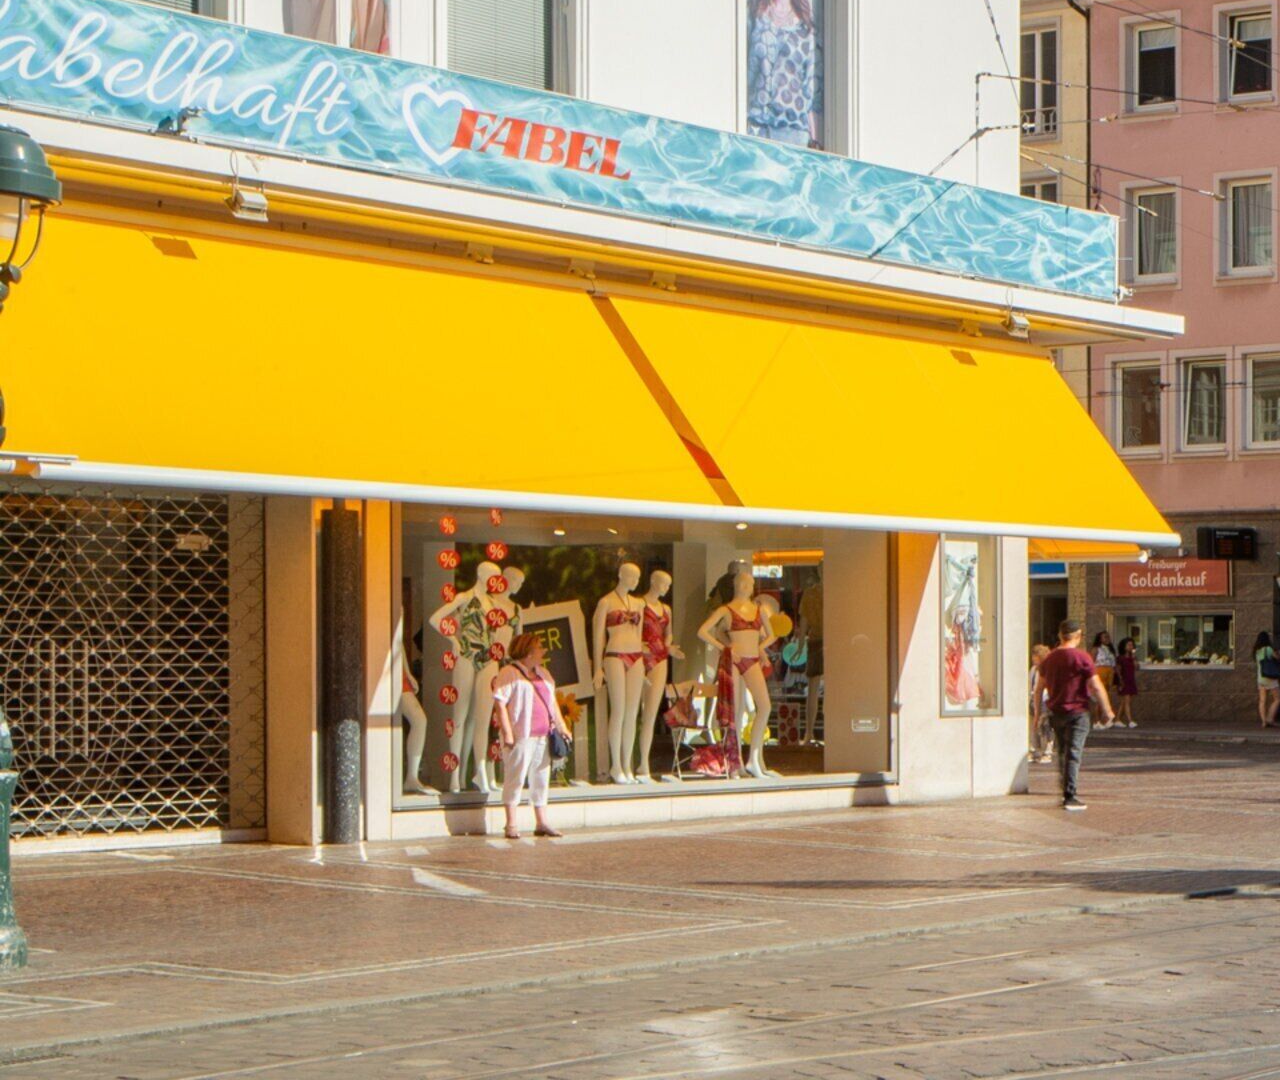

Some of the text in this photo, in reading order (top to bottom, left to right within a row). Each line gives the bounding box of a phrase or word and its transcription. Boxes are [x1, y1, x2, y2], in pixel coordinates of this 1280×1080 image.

[452, 108, 632, 181] FABEL
[1148, 559, 1187, 571] Freiburger
[1129, 571, 1207, 588] Goldankauf
